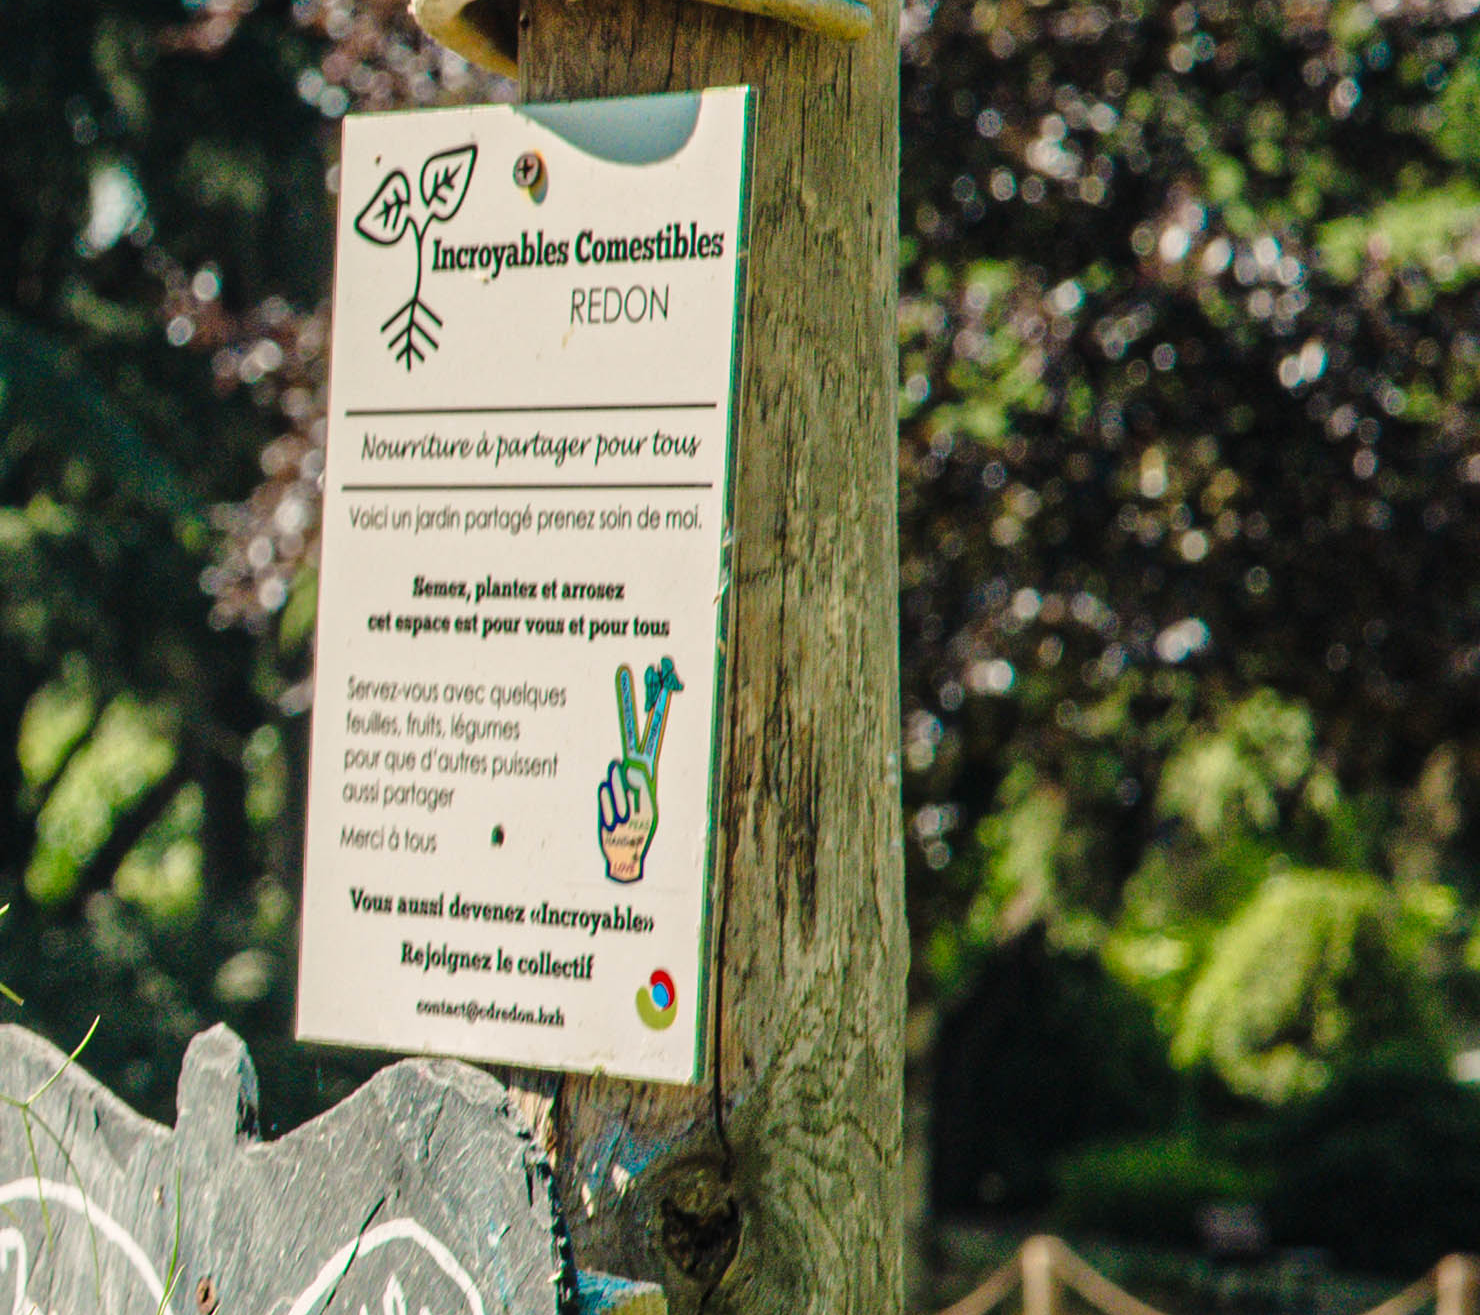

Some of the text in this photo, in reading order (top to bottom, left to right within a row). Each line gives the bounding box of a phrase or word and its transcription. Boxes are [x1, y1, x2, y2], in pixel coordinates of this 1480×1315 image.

[432, 221, 725, 279] Incroyables Comestibles
[570, 284, 669, 324] REDON
[361, 429, 701, 468] Nourriture à partager pour tous
[349, 503, 702, 536] Voici un jardin partagé prenez soin de moi.
[413, 573, 625, 604] Semez, plantez et arrosez
[368, 610, 670, 641] cet espace est pour vous et pour tous
[347, 676, 567, 711] Servez-vous avec quelques
[346, 710, 520, 744] feuilles, fruits, légumes
[344, 748, 380, 772] pour
[384, 750, 416, 775] que
[492, 751, 558, 780] puissent
[342, 779, 454, 813] aussi partager
[340, 825, 437, 854] Merci à tous
[350, 887, 392, 913] Vous
[397, 892, 444, 917] aussi
[449, 893, 525, 924] devenez
[400, 940, 594, 981] Rejoignez le collectif
